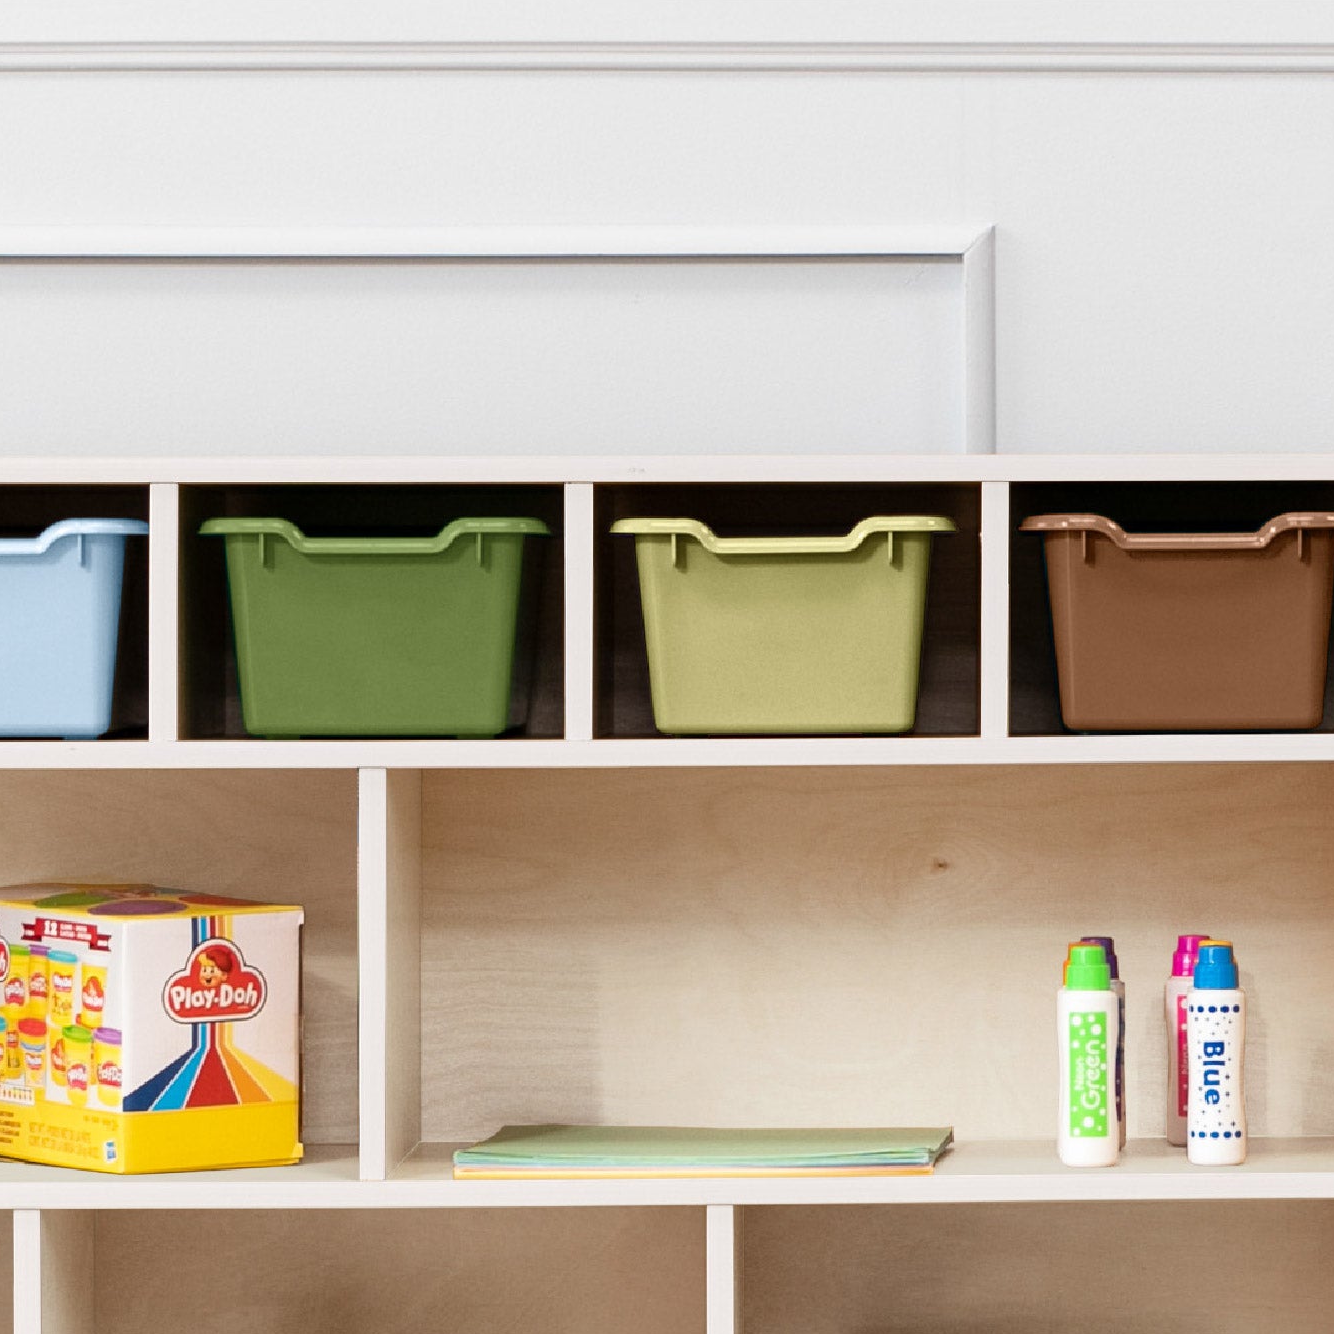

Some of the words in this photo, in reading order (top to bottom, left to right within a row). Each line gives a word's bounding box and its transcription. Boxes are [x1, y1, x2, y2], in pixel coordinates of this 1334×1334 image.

[170, 982, 258, 1012] Play-Doh
[1080, 1039, 1101, 1110] Green
[1203, 1041, 1226, 1106] Blue
